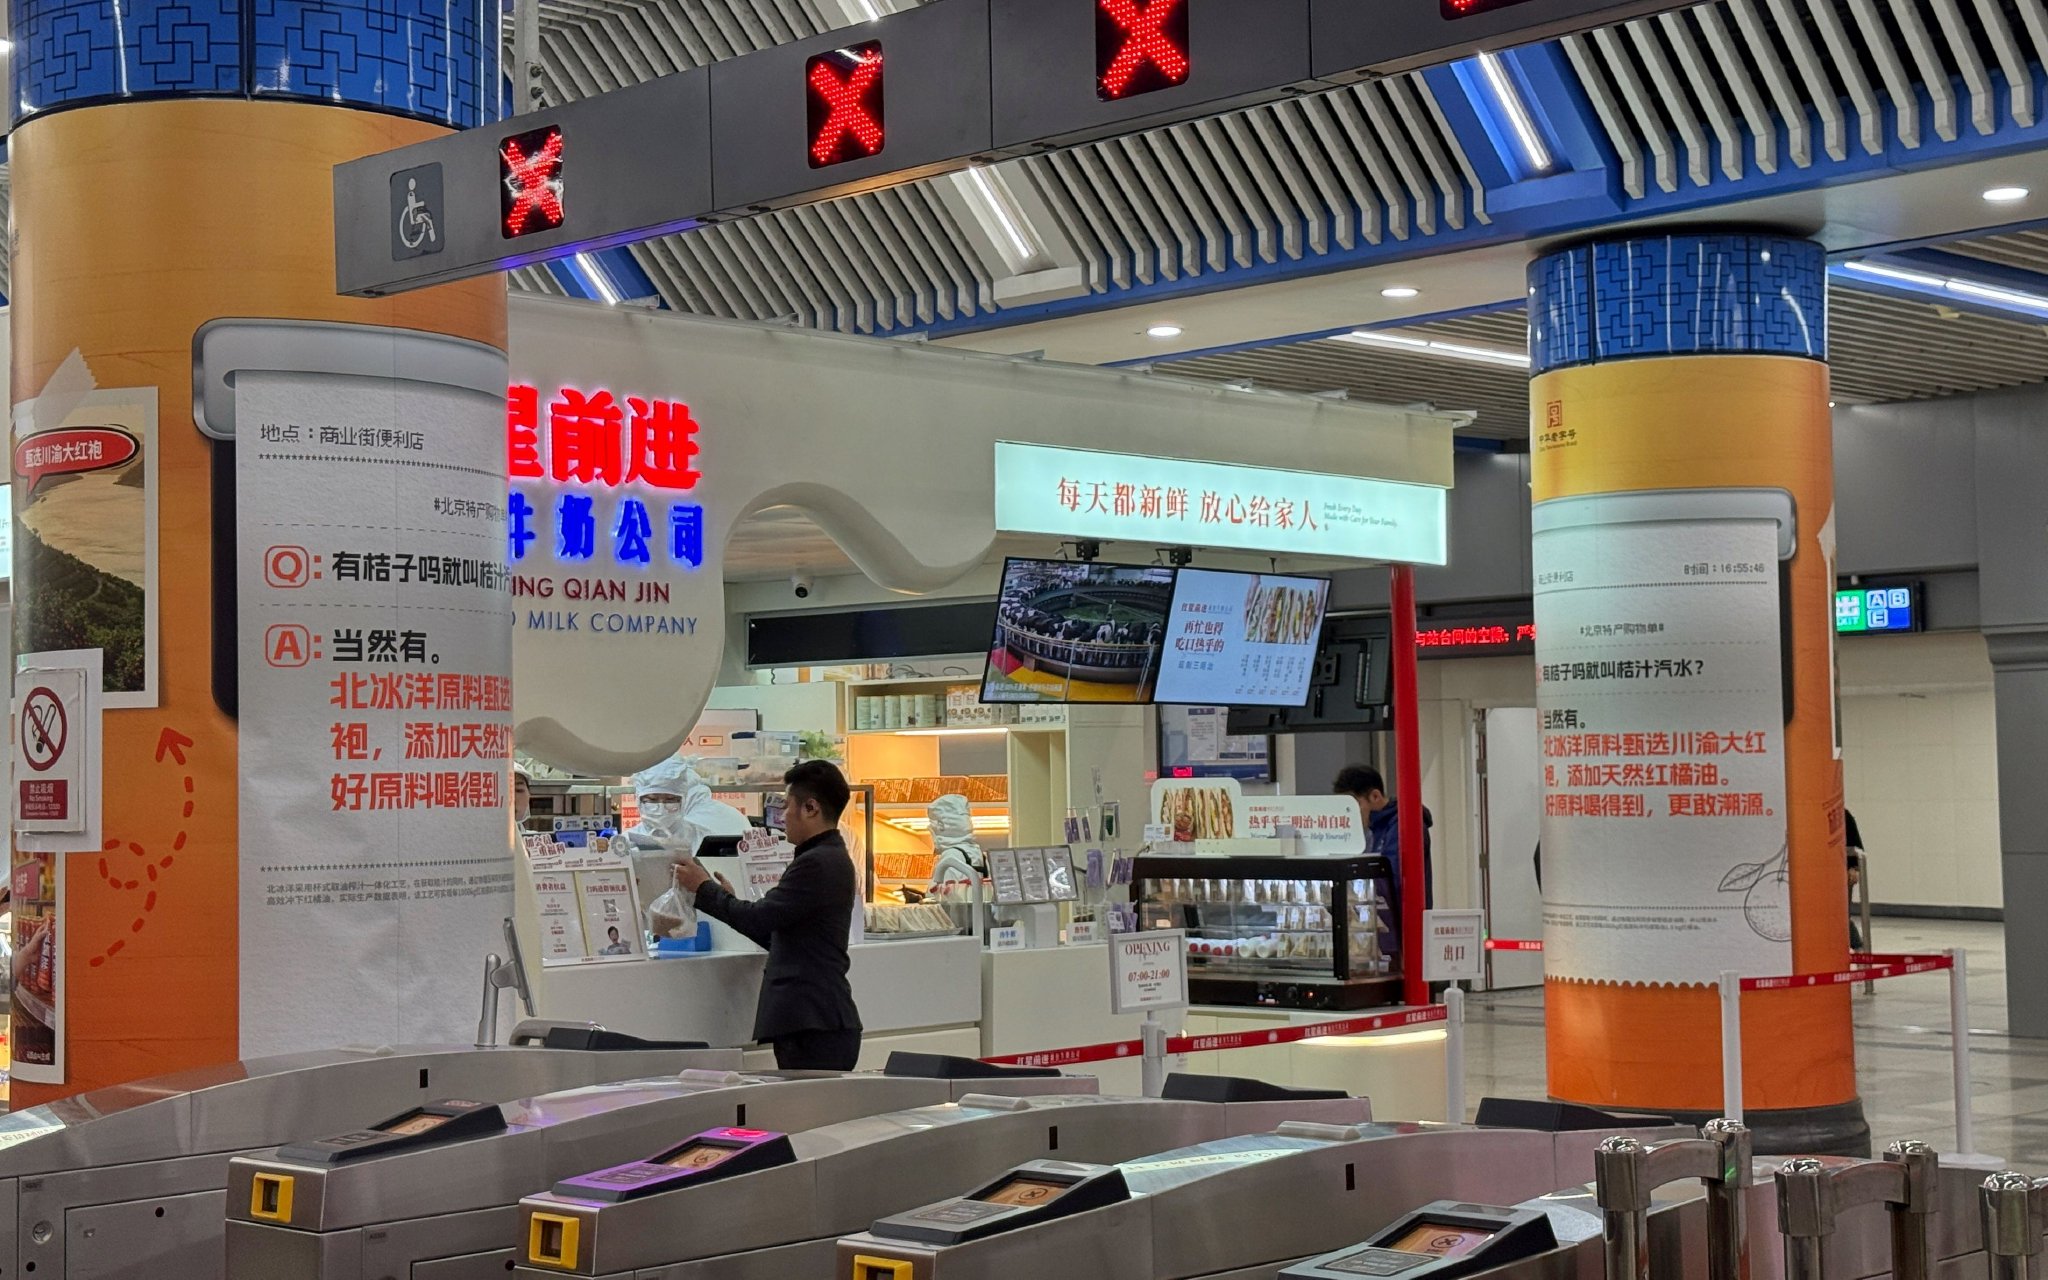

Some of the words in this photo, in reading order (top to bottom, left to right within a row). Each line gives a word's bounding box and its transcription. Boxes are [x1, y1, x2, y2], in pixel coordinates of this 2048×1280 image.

[25, 439, 103, 468] 甄选川渝大红袍
[1056, 476, 1189, 521] 每天都新鲜
[1198, 489, 1318, 532] 放心给家人
[564, 578, 626, 602] QIAN
[635, 582, 670, 603] JIN
[529, 610, 579, 631] MILK
[591, 613, 698, 635] COMPANY
[333, 629, 440, 664] 当然有。
[1444, 945, 1465, 961] 出口
[1128, 969, 1170, 982] 07:00-21:00
